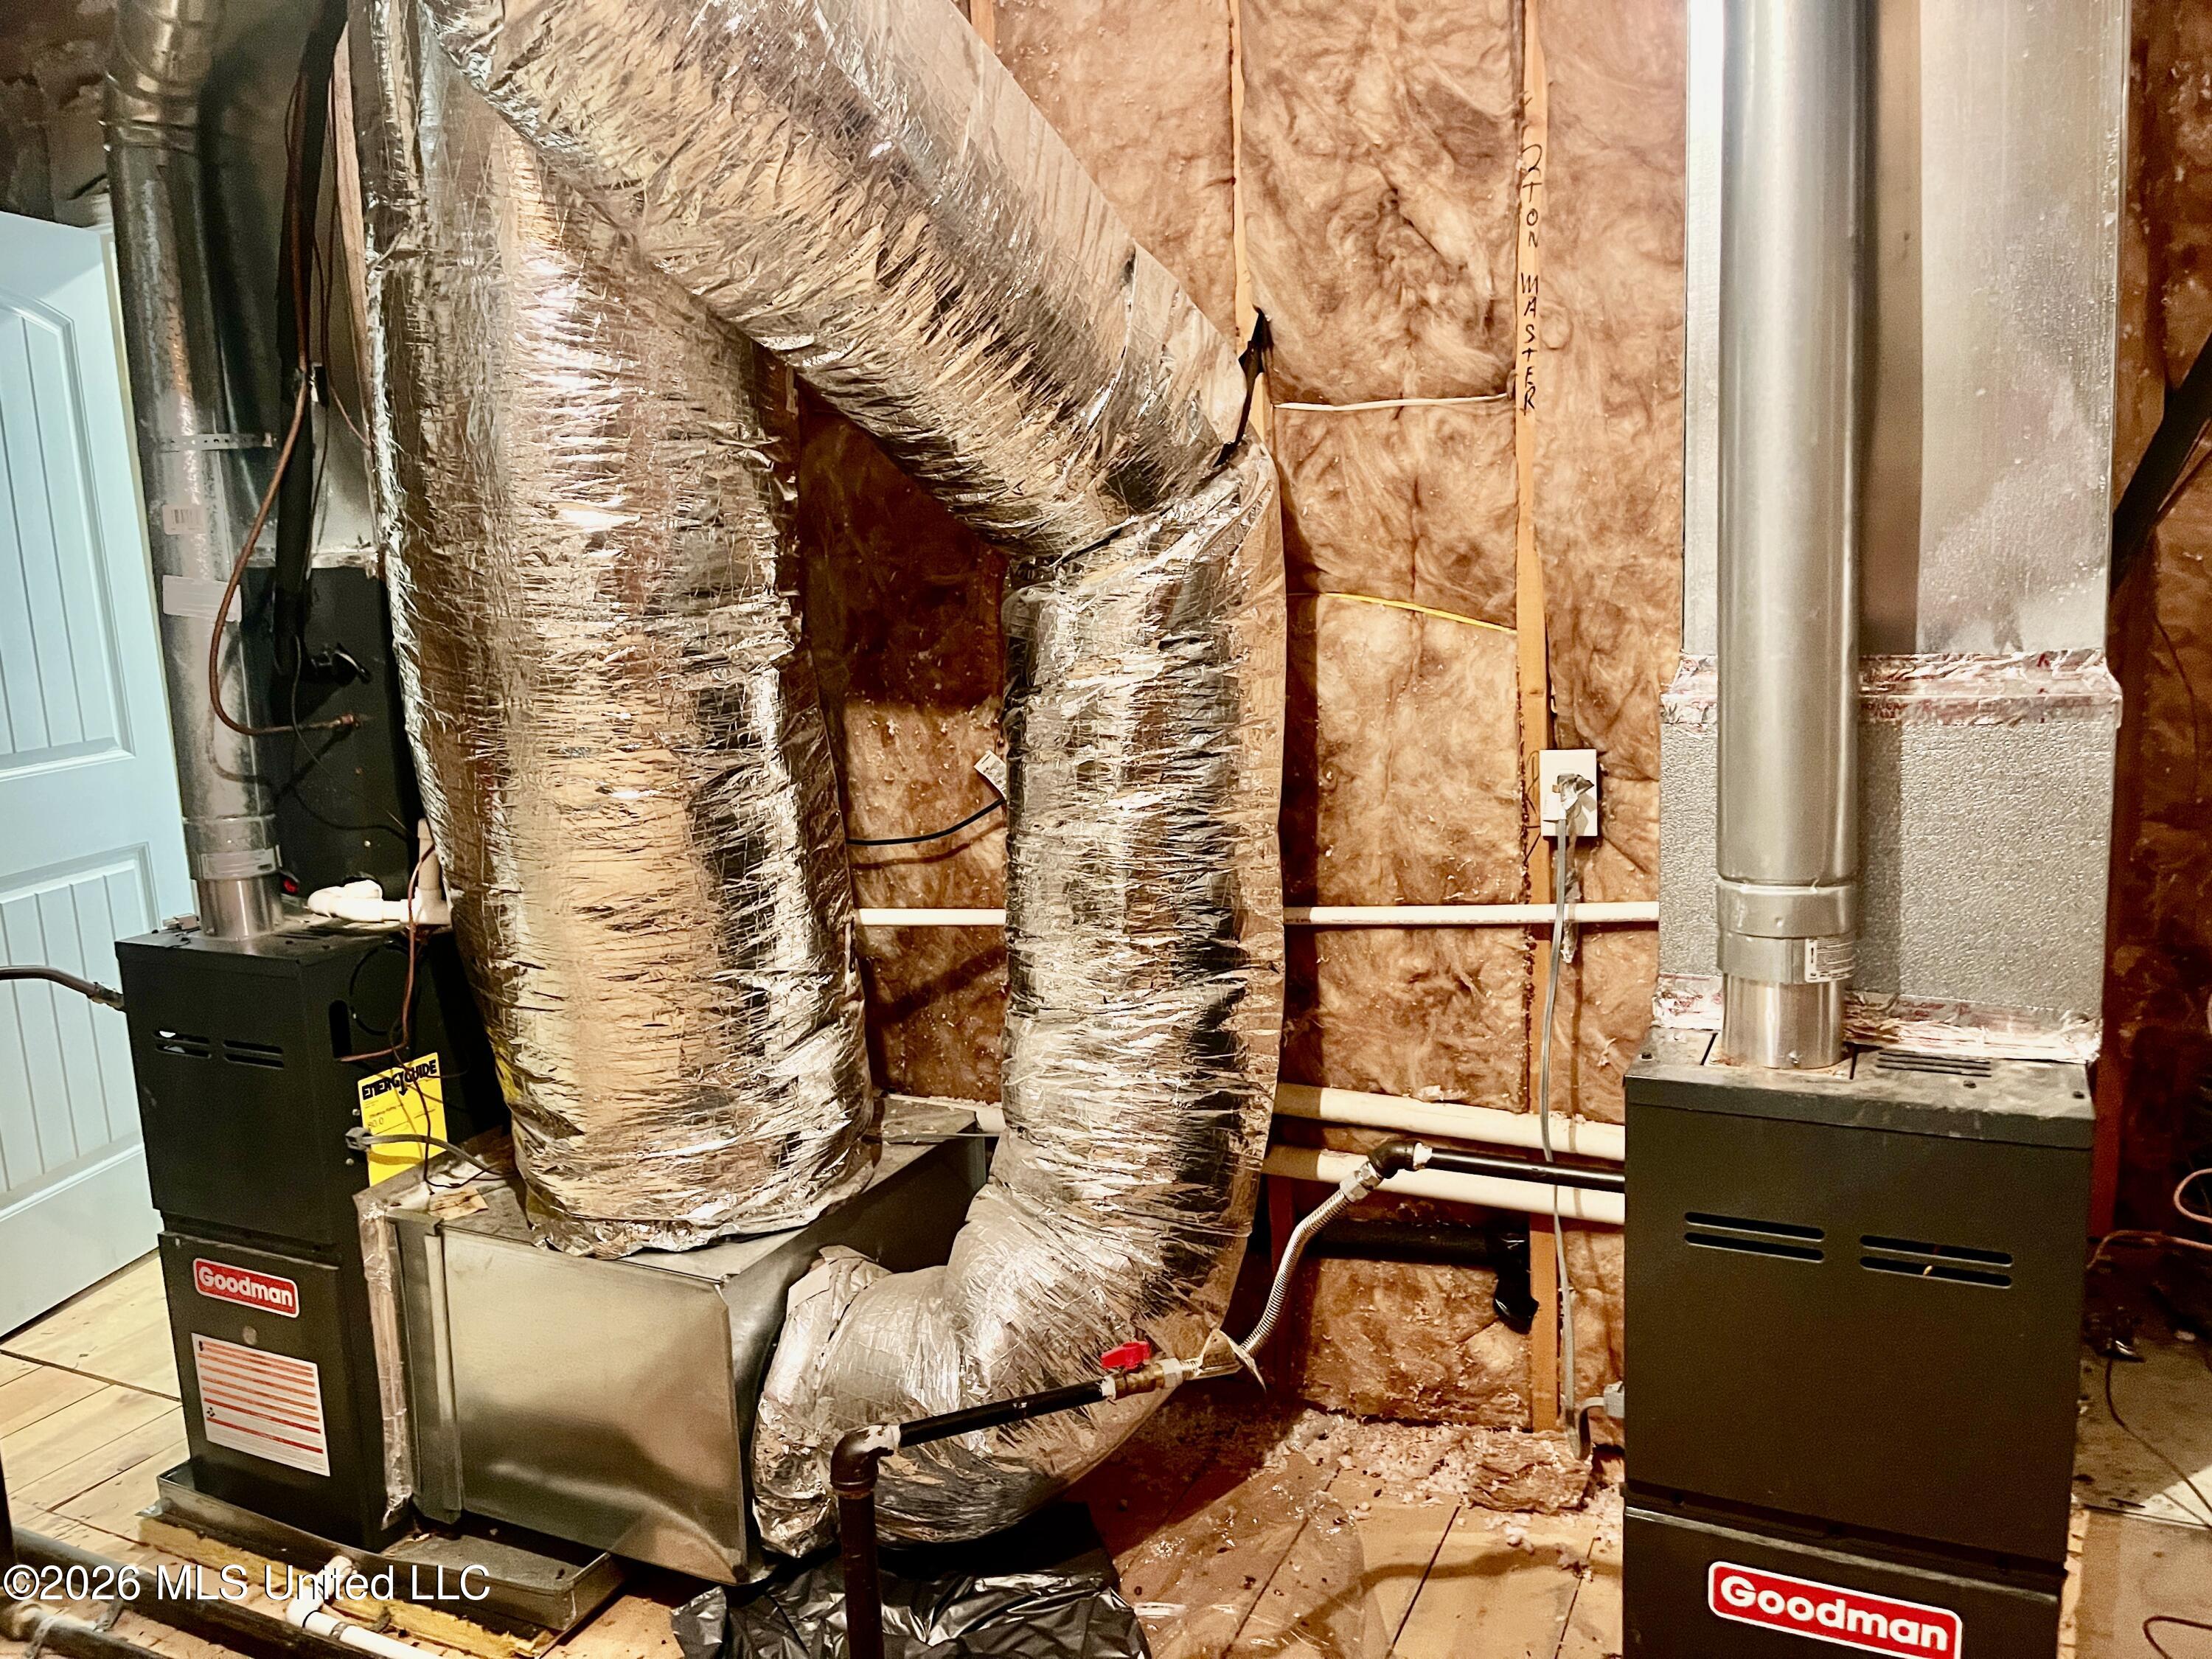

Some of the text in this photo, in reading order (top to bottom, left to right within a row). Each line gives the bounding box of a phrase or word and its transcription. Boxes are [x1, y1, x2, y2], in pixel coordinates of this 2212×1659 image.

[1520, 272, 1539, 417] MASTER
[198, 1265, 293, 1307] Goodman
[1720, 1575, 1949, 1652] Goodman
